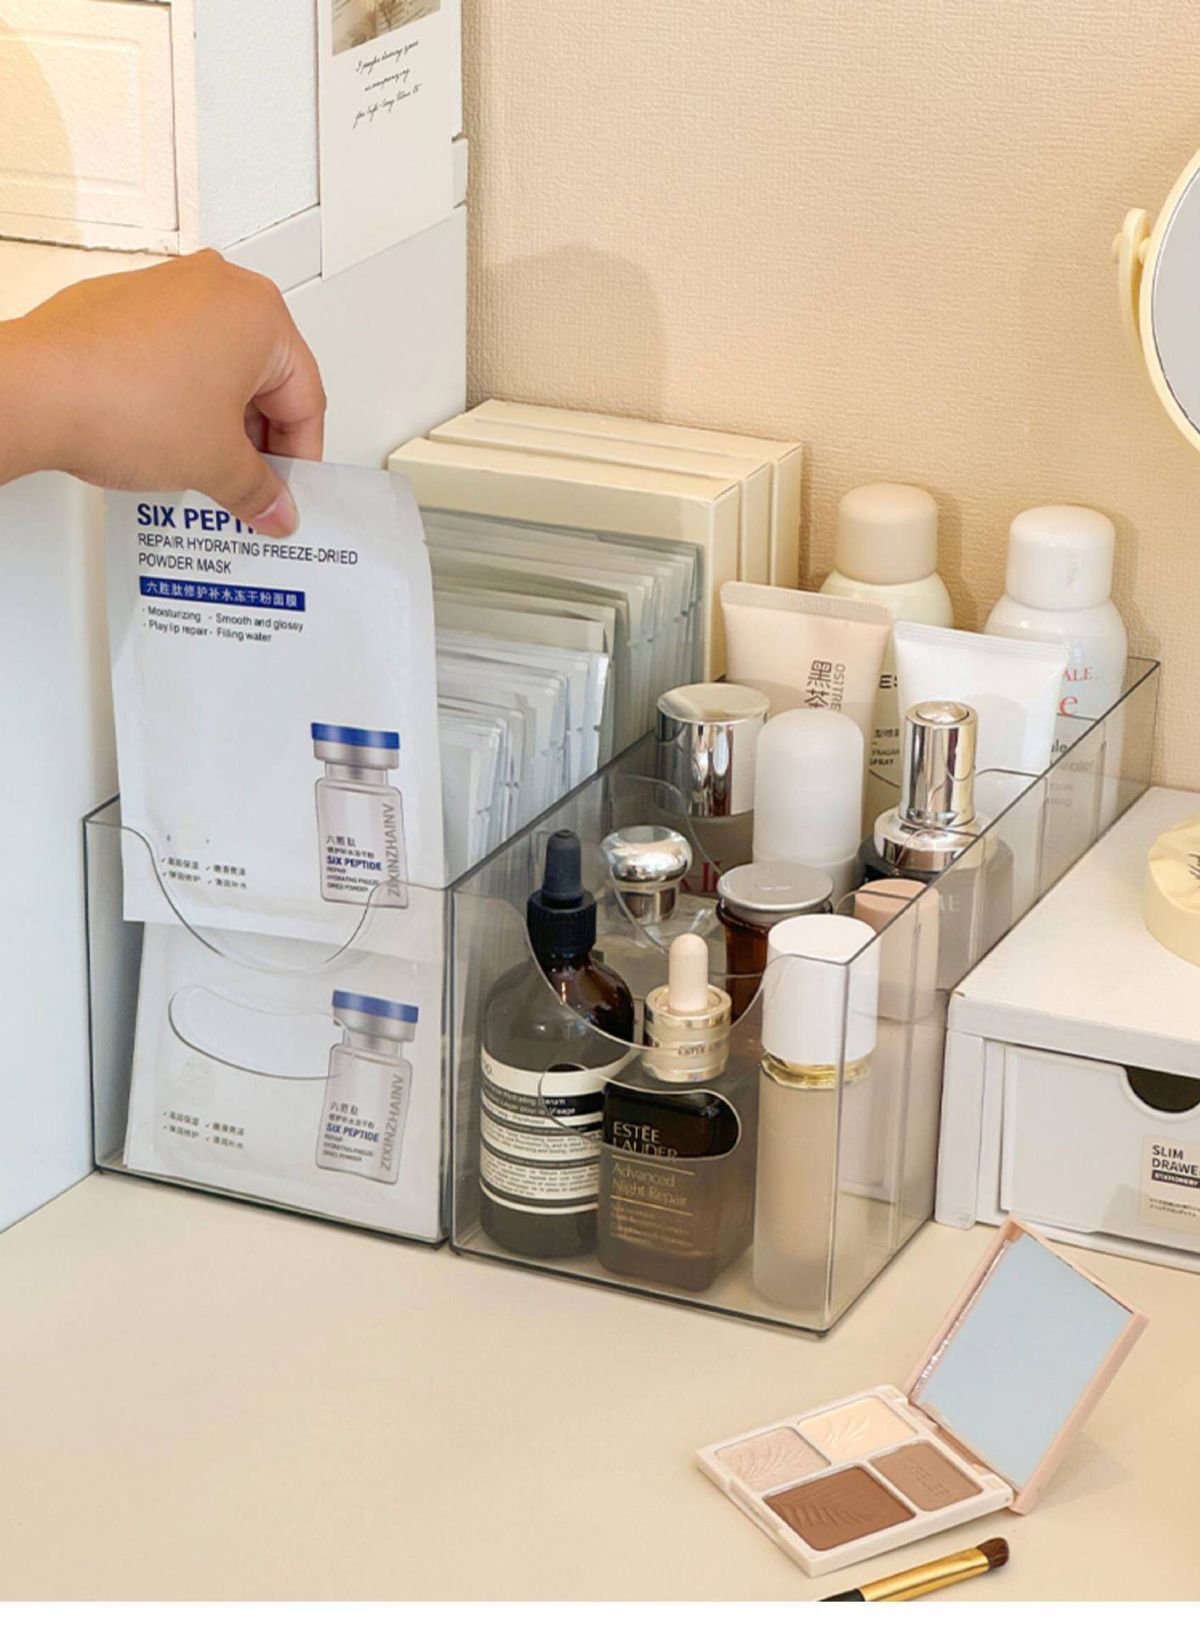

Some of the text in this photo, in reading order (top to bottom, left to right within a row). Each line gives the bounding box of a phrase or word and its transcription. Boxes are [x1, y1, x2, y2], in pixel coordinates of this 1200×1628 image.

[137, 503, 176, 529] SIX
[137, 532, 358, 565] REPAIR HYDRATING FREEZE-DRIED
[138, 551, 231, 575] POWDER MASK
[148, 606, 303, 633] Moisturizing Smooth and glossy
[149, 620, 167, 633] Play
[182, 626, 208, 637] repair
[217, 628, 244, 642] Filling
[245, 632, 271, 642] water
[327, 855, 382, 871] SIX PEPTIDE
[326, 1122, 341, 1133] SIX
[342, 1126, 380, 1142] PEPTIDE
[1152, 1144, 1184, 1161] SLIM
[1152, 1157, 1200, 1177] DRAWE
